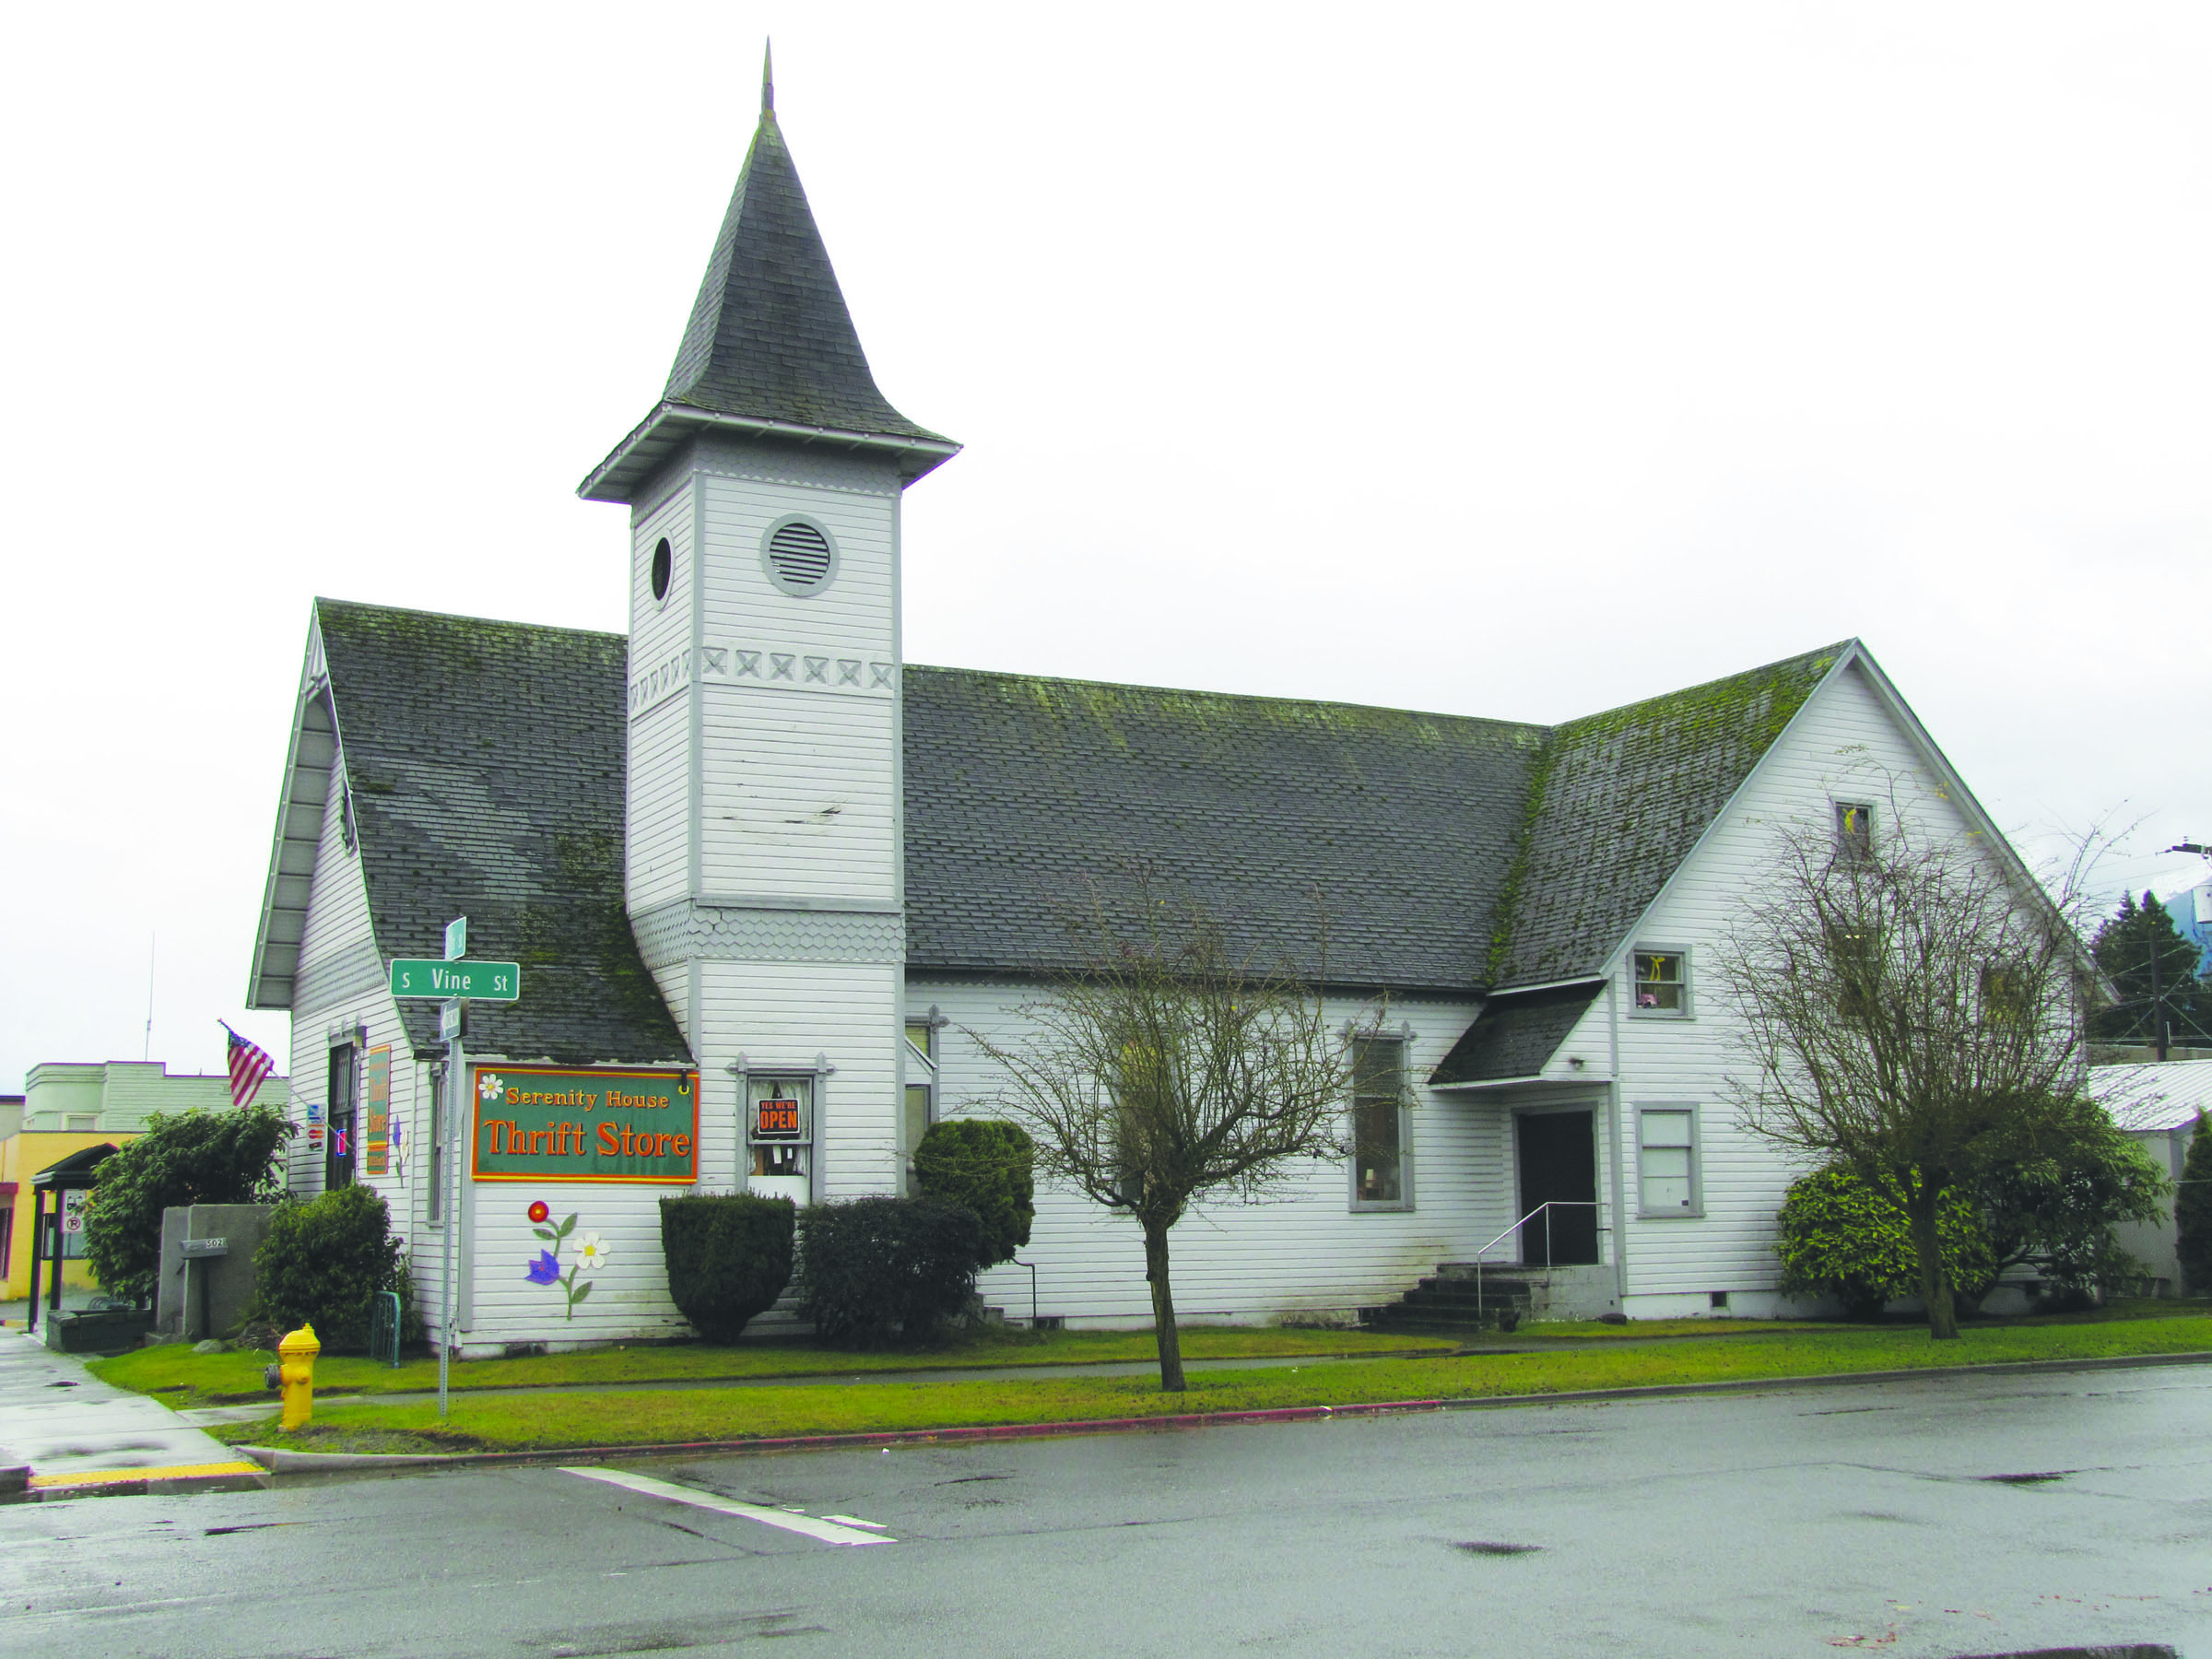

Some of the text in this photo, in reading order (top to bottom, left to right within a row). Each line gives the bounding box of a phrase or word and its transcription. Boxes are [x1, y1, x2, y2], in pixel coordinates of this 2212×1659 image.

[402, 968, 508, 992] S Vine St
[506, 1087, 670, 1112] Serenity House
[760, 1101, 796, 1110] YES WE'RE
[759, 1111, 798, 1129] OPEN
[483, 1119, 690, 1157] Thrift Store
[206, 1239, 223, 1247] 502
